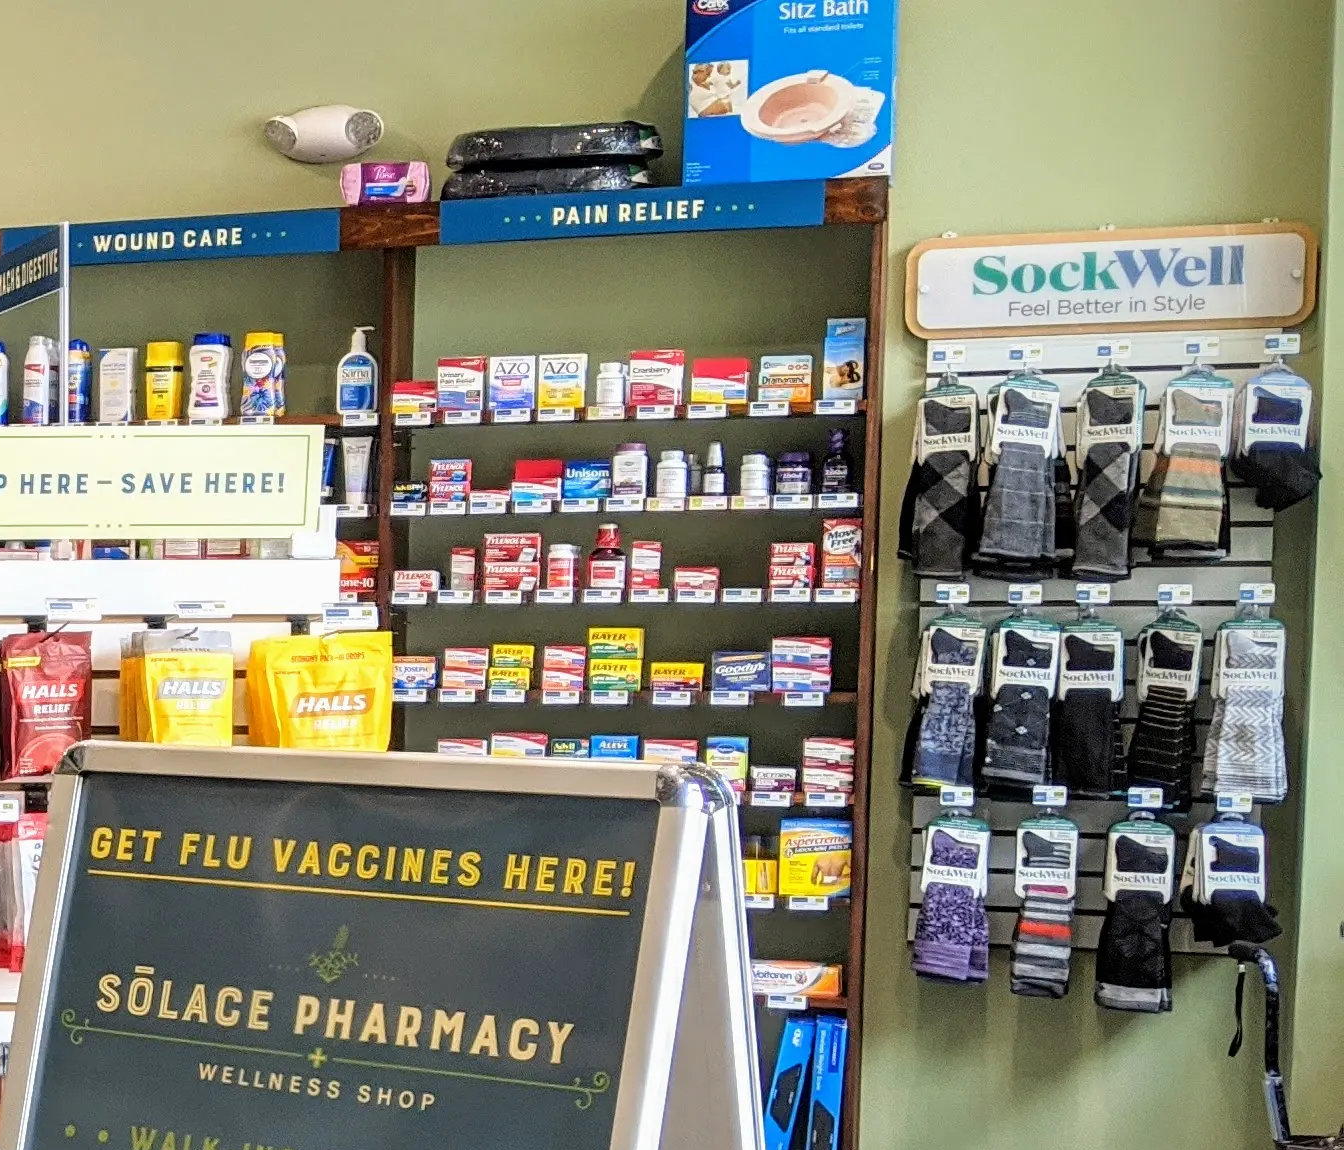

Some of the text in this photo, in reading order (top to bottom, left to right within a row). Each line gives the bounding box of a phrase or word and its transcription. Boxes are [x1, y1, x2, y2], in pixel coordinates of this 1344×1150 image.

[779, 0, 869, 20] Sitz Bath
[553, 200, 705, 227] PAIN RELIEF
[93, 227, 242, 253] WOUND CARE
[21, 248, 58, 284] DIGESTIVE
[972, 244, 1245, 296] SockWell
[1008, 294, 1206, 318] Feel Better in Style
[341, 368, 370, 380] Sarna
[495, 362, 530, 374] AZO
[544, 362, 579, 374] AZO
[633, 367, 671, 377] Cranberry
[566, 467, 610, 479] Unisom
[20, 473, 89, 494] HERE
[121, 472, 193, 494] SAVE
[204, 471, 285, 494] HERE!
[827, 528, 857, 542] Move
[831, 537, 854, 549] Free
[715, 662, 765, 675] Goody's
[22, 684, 78, 699] HALLS
[162, 680, 221, 696] HALLS
[33, 704, 71, 714] RELIEF
[296, 694, 367, 713] HALLS
[313, 718, 358, 730] RELIEF
[599, 740, 629, 751] ALEVE
[785, 835, 847, 848] Aspercreme
[90, 827, 637, 897] GET FLU VACCINES HERE!
[752, 970, 793, 982] Voltaren
[97, 965, 575, 1064] SŌLACE PHARMACY
[199, 1063, 436, 1111] WELLNESS SHOP
